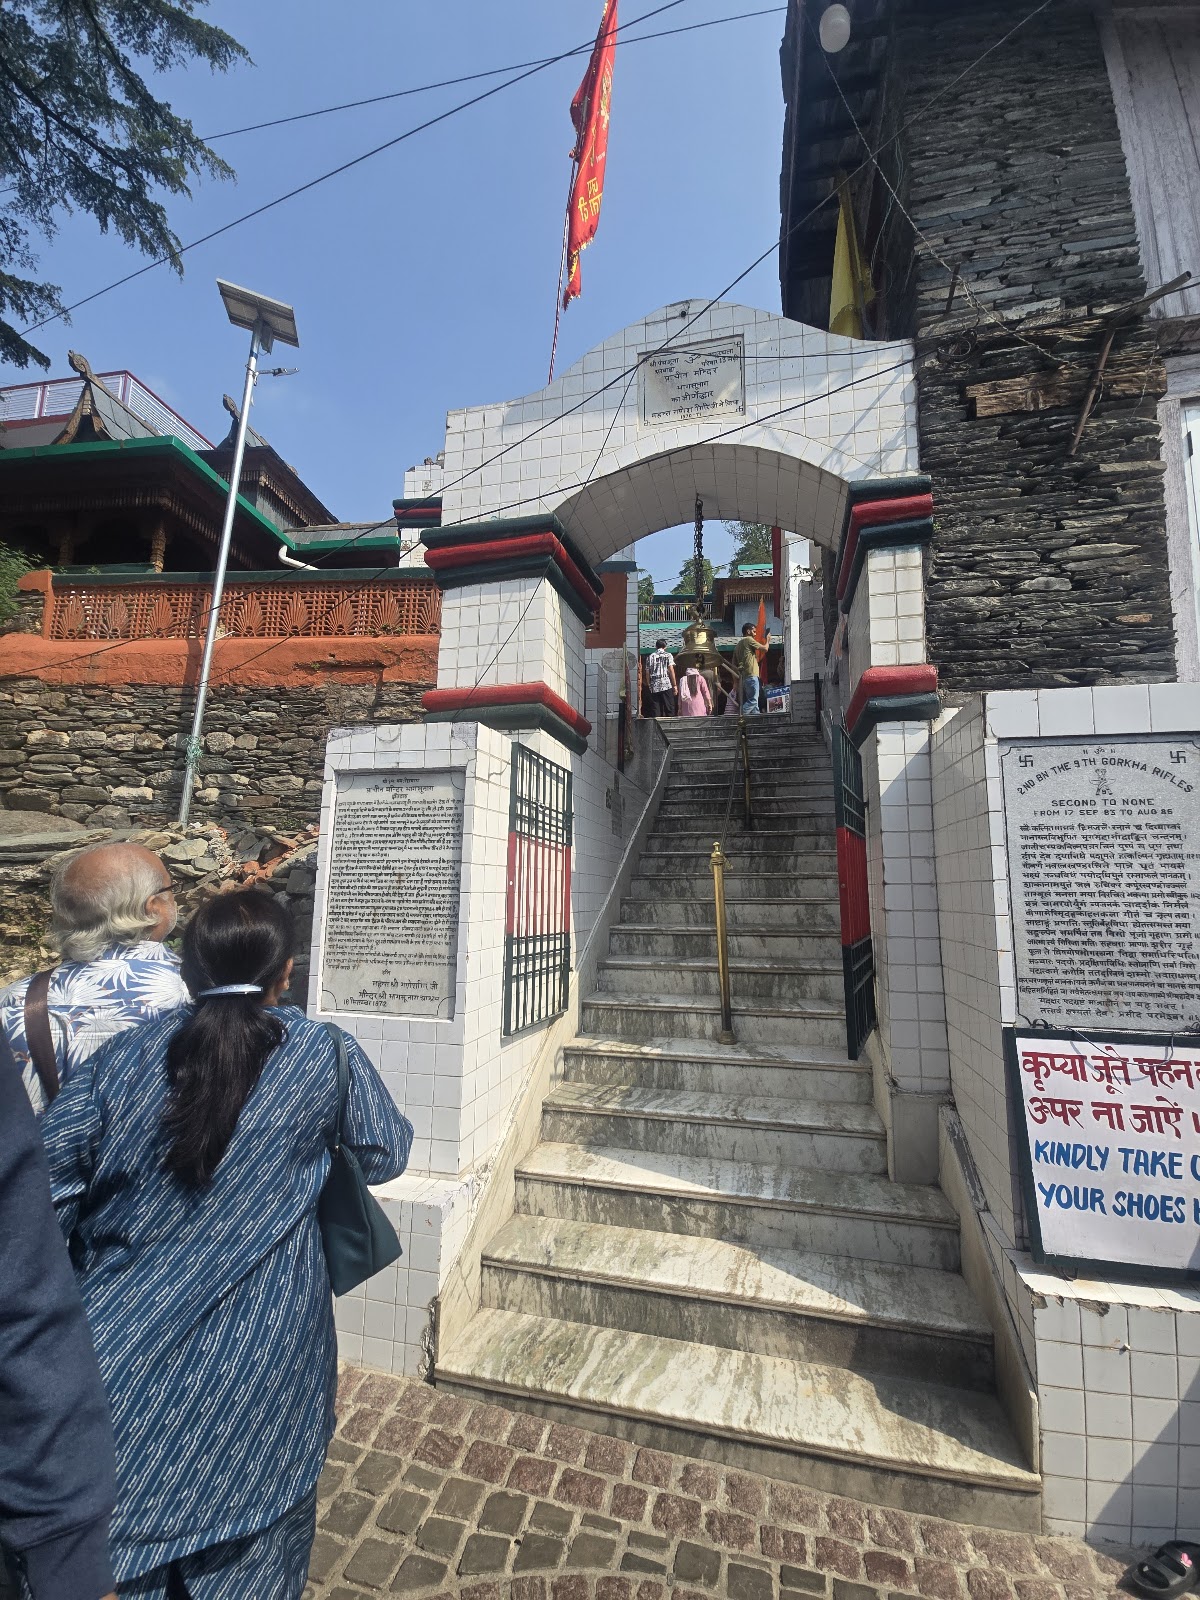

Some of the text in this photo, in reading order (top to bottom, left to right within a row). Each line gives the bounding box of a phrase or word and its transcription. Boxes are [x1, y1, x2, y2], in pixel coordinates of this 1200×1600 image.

[1017, 779, 1036, 796] 2ND
[1035, 770, 1050, 784] BN
[1050, 761, 1072, 776] THE
[1101, 757, 1148, 773] GORKHA
[1151, 766, 1194, 795] RIFLES
[1033, 809, 1060, 818] FROM
[1063, 809, 1073, 817] 17
[1136, 808, 1158, 816] AUG
[1051, 797, 1155, 807] SECOND TO NONE
[1022, 1051, 1088, 1092] कृप्या
[1091, 1045, 1132, 1095] जूते
[1133, 1056, 1195, 1090] पहन
[1027, 1096, 1085, 1130] ऊपर
[1091, 1102, 1126, 1132] ना
[1034, 1139, 1110, 1173] KINDLY
[1118, 1147, 1184, 1180] TAKE
[1038, 1182, 1108, 1216] YOUR
[1112, 1191, 1187, 1225] SHOES
